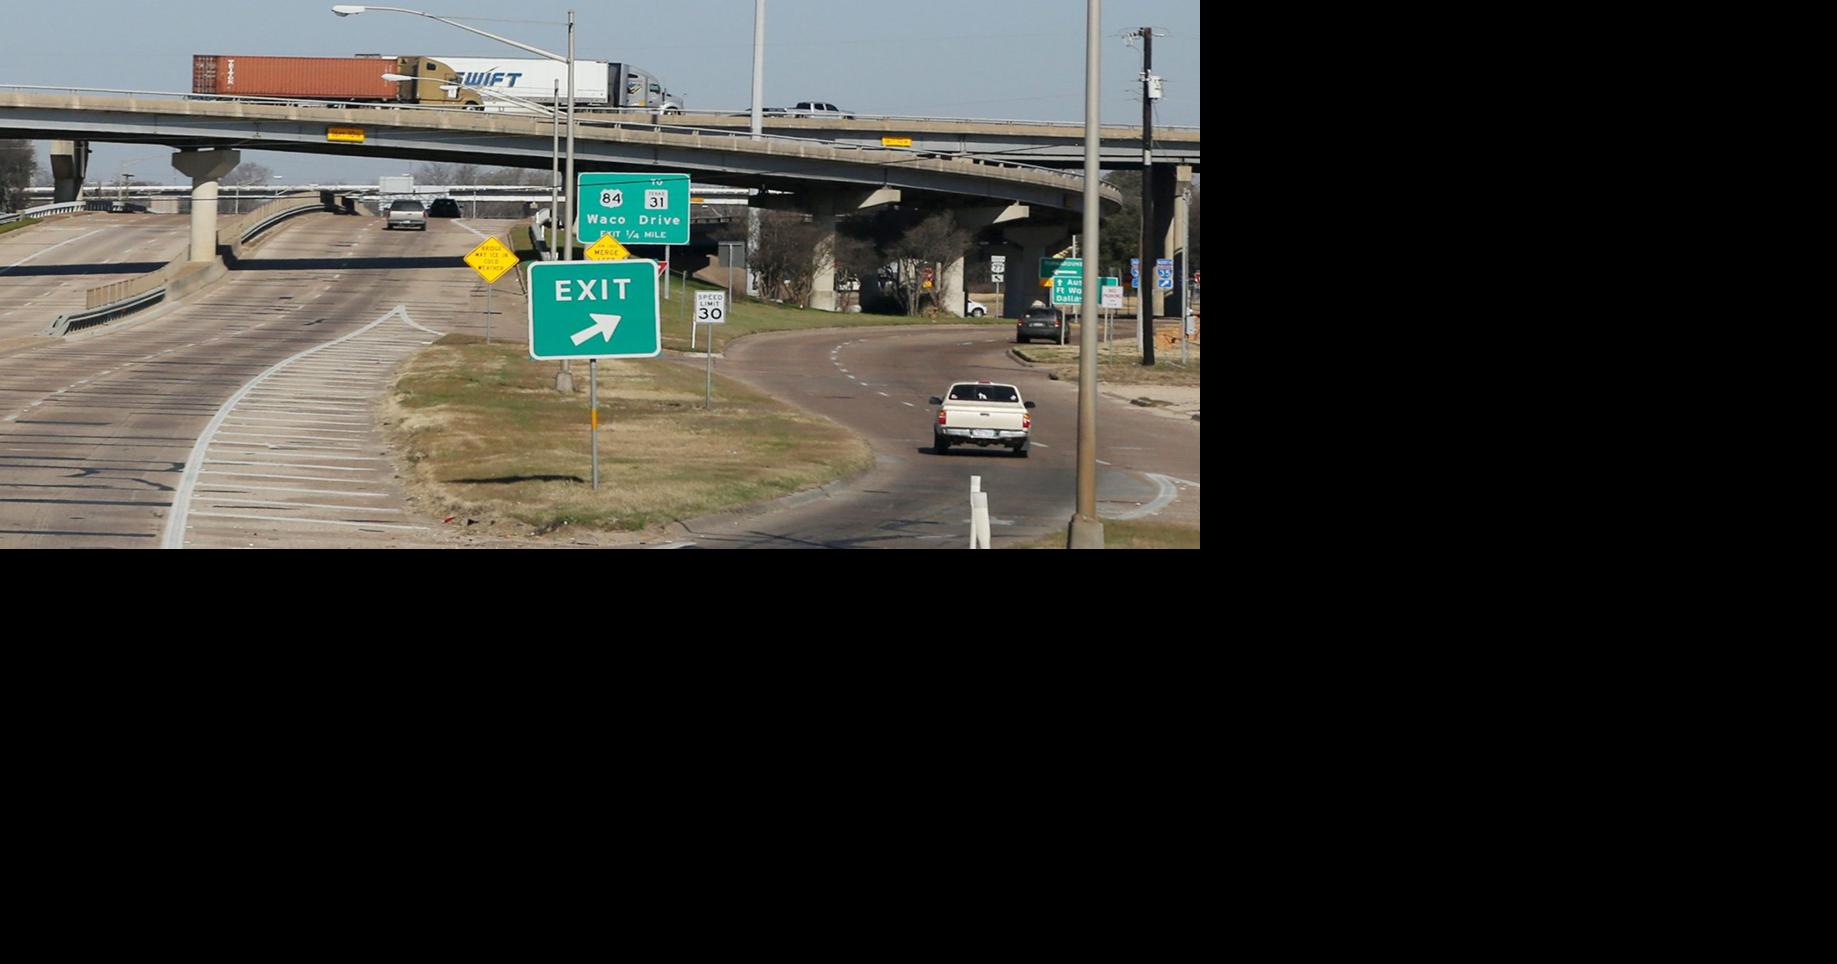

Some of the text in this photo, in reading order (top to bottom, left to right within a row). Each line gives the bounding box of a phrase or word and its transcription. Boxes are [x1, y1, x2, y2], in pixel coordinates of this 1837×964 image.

[456, 72, 522, 87] SWIFT
[651, 178, 664, 186] TO
[602, 192, 621, 204] 84
[649, 197, 664, 208] 31
[587, 213, 681, 225] Waco Drive
[644, 231, 667, 239] MILE
[555, 278, 632, 302] EXIT
[698, 307, 722, 320] 30
